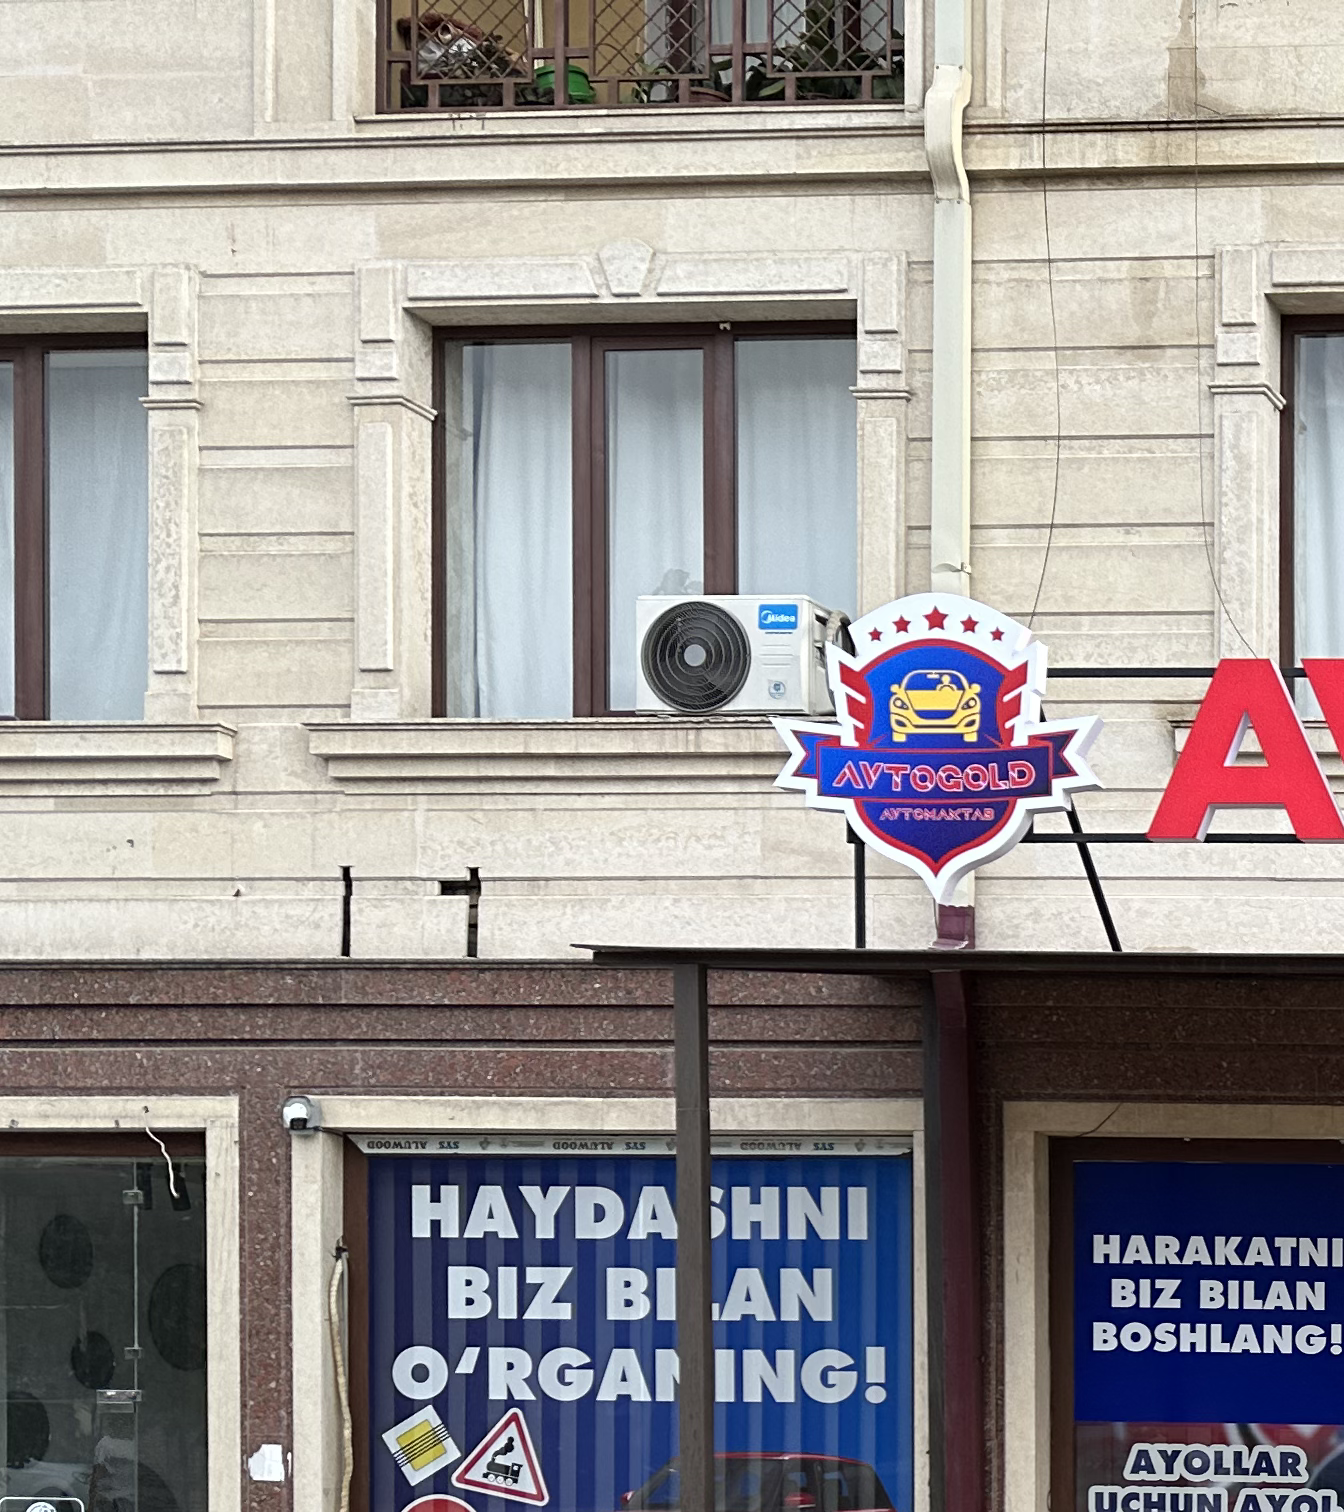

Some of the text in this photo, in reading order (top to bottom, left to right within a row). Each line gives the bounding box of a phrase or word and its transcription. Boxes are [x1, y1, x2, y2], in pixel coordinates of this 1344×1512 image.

[760, 610, 796, 624] Midea
[832, 760, 1036, 793] AVTOGOLD
[1092, 1234, 1344, 1268] HARAKATNI
[447, 1265, 833, 1322] BIZ BIAN
[1110, 1277, 1326, 1311] BIZ BILAN
[1092, 1321, 1344, 1356] BOSHLANG!
[1129, 1449, 1304, 1477] AYOLLAR
